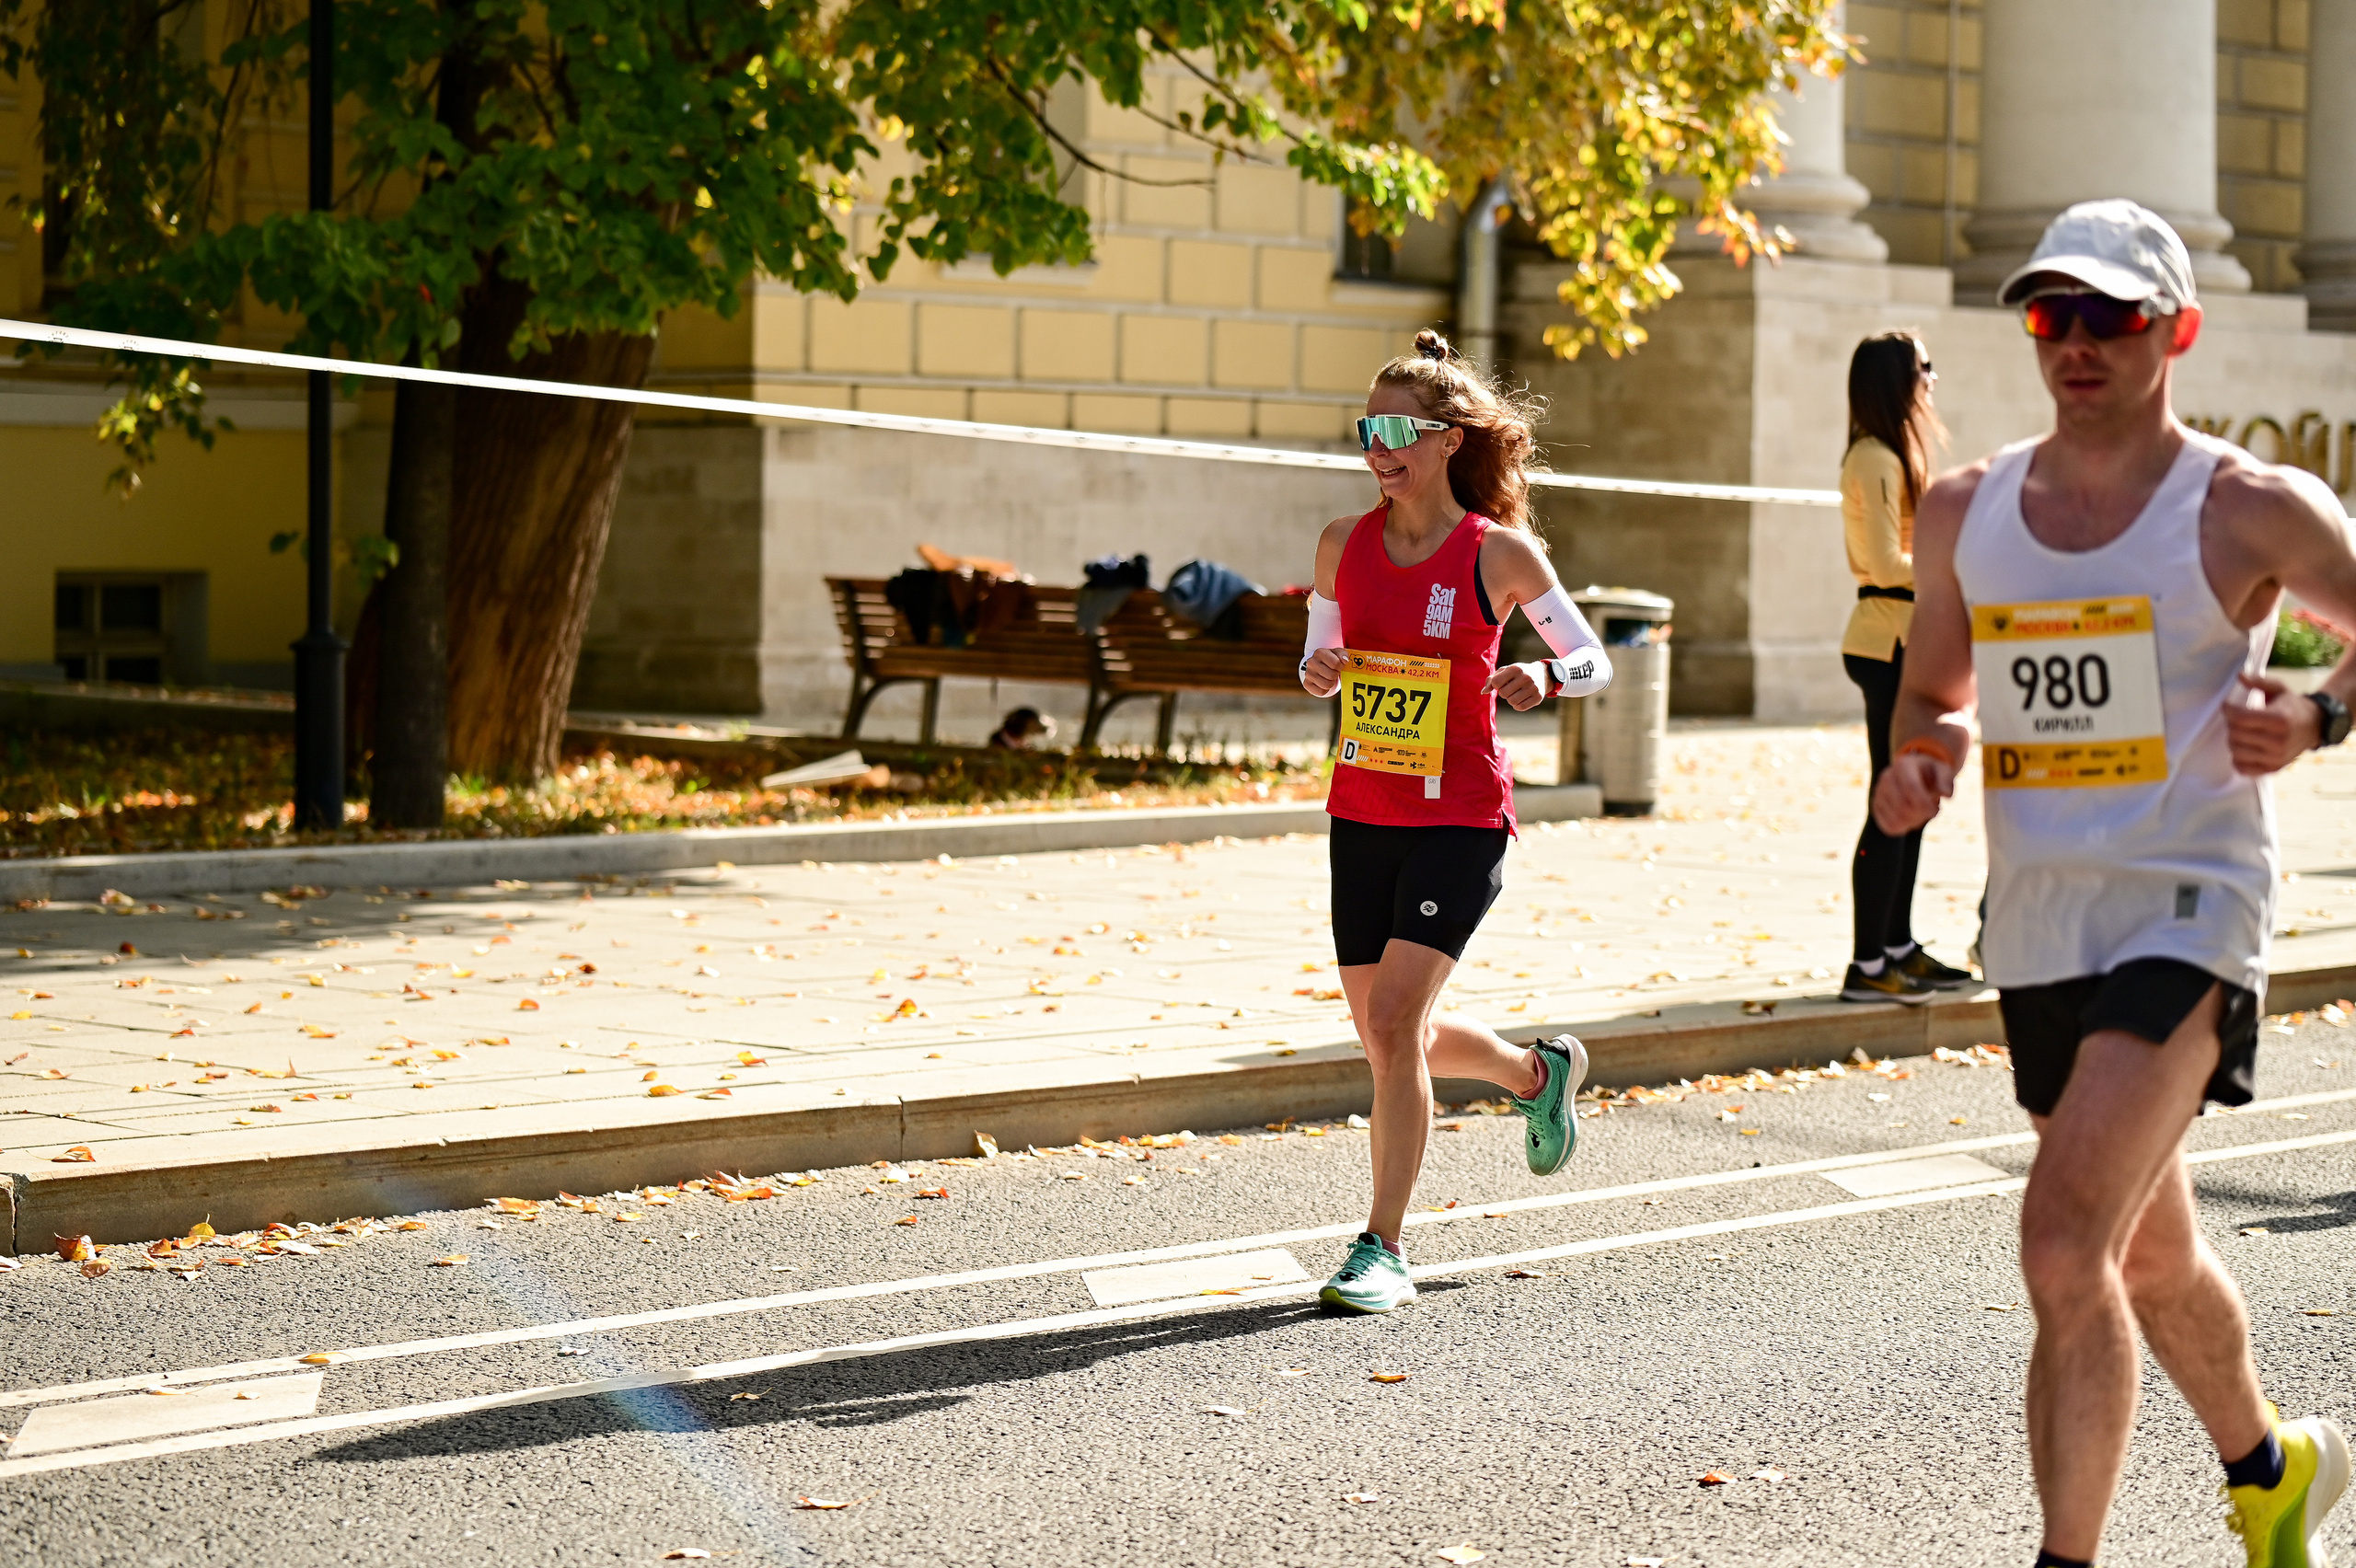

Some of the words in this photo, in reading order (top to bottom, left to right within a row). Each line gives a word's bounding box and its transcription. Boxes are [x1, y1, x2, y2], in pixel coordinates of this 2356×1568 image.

[1429, 582, 1456, 607] Sat
[1426, 604, 1453, 623] 9AM
[1423, 619, 1451, 640] 5KM
[1366, 655, 1407, 667] МАРАФОН
[1366, 663, 1399, 674] МОСКВА
[1407, 669, 1425, 677] 42,2
[2011, 652, 2111, 711] 980
[1352, 681, 1432, 726] 5737
[1355, 721, 1421, 740] АЛЕКСАНДРА
[1344, 741, 1356, 760] D
[1998, 747, 2021, 780] D
